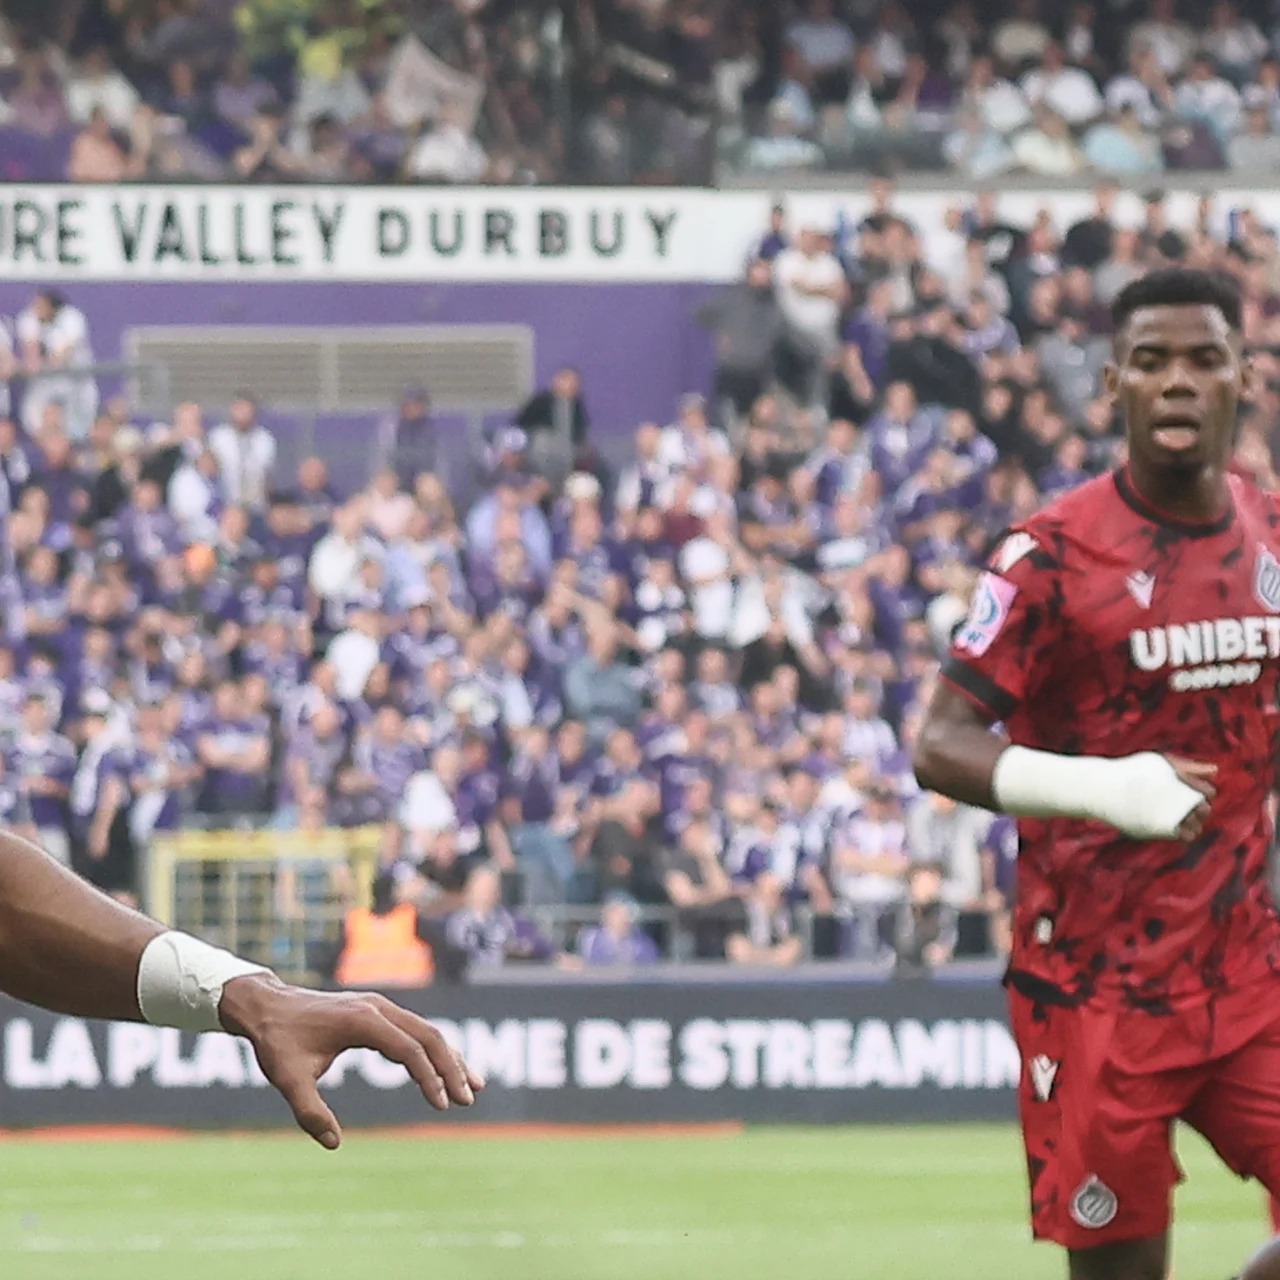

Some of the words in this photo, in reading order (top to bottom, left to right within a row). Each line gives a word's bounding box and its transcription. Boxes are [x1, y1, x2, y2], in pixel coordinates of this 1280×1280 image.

[110, 198, 345, 265] VALLEY
[377, 207, 677, 258] DURBUY
[1129, 614, 1280, 671] UNIBET
[3, 1017, 101, 1089] LA
[574, 1019, 673, 1089] DE
